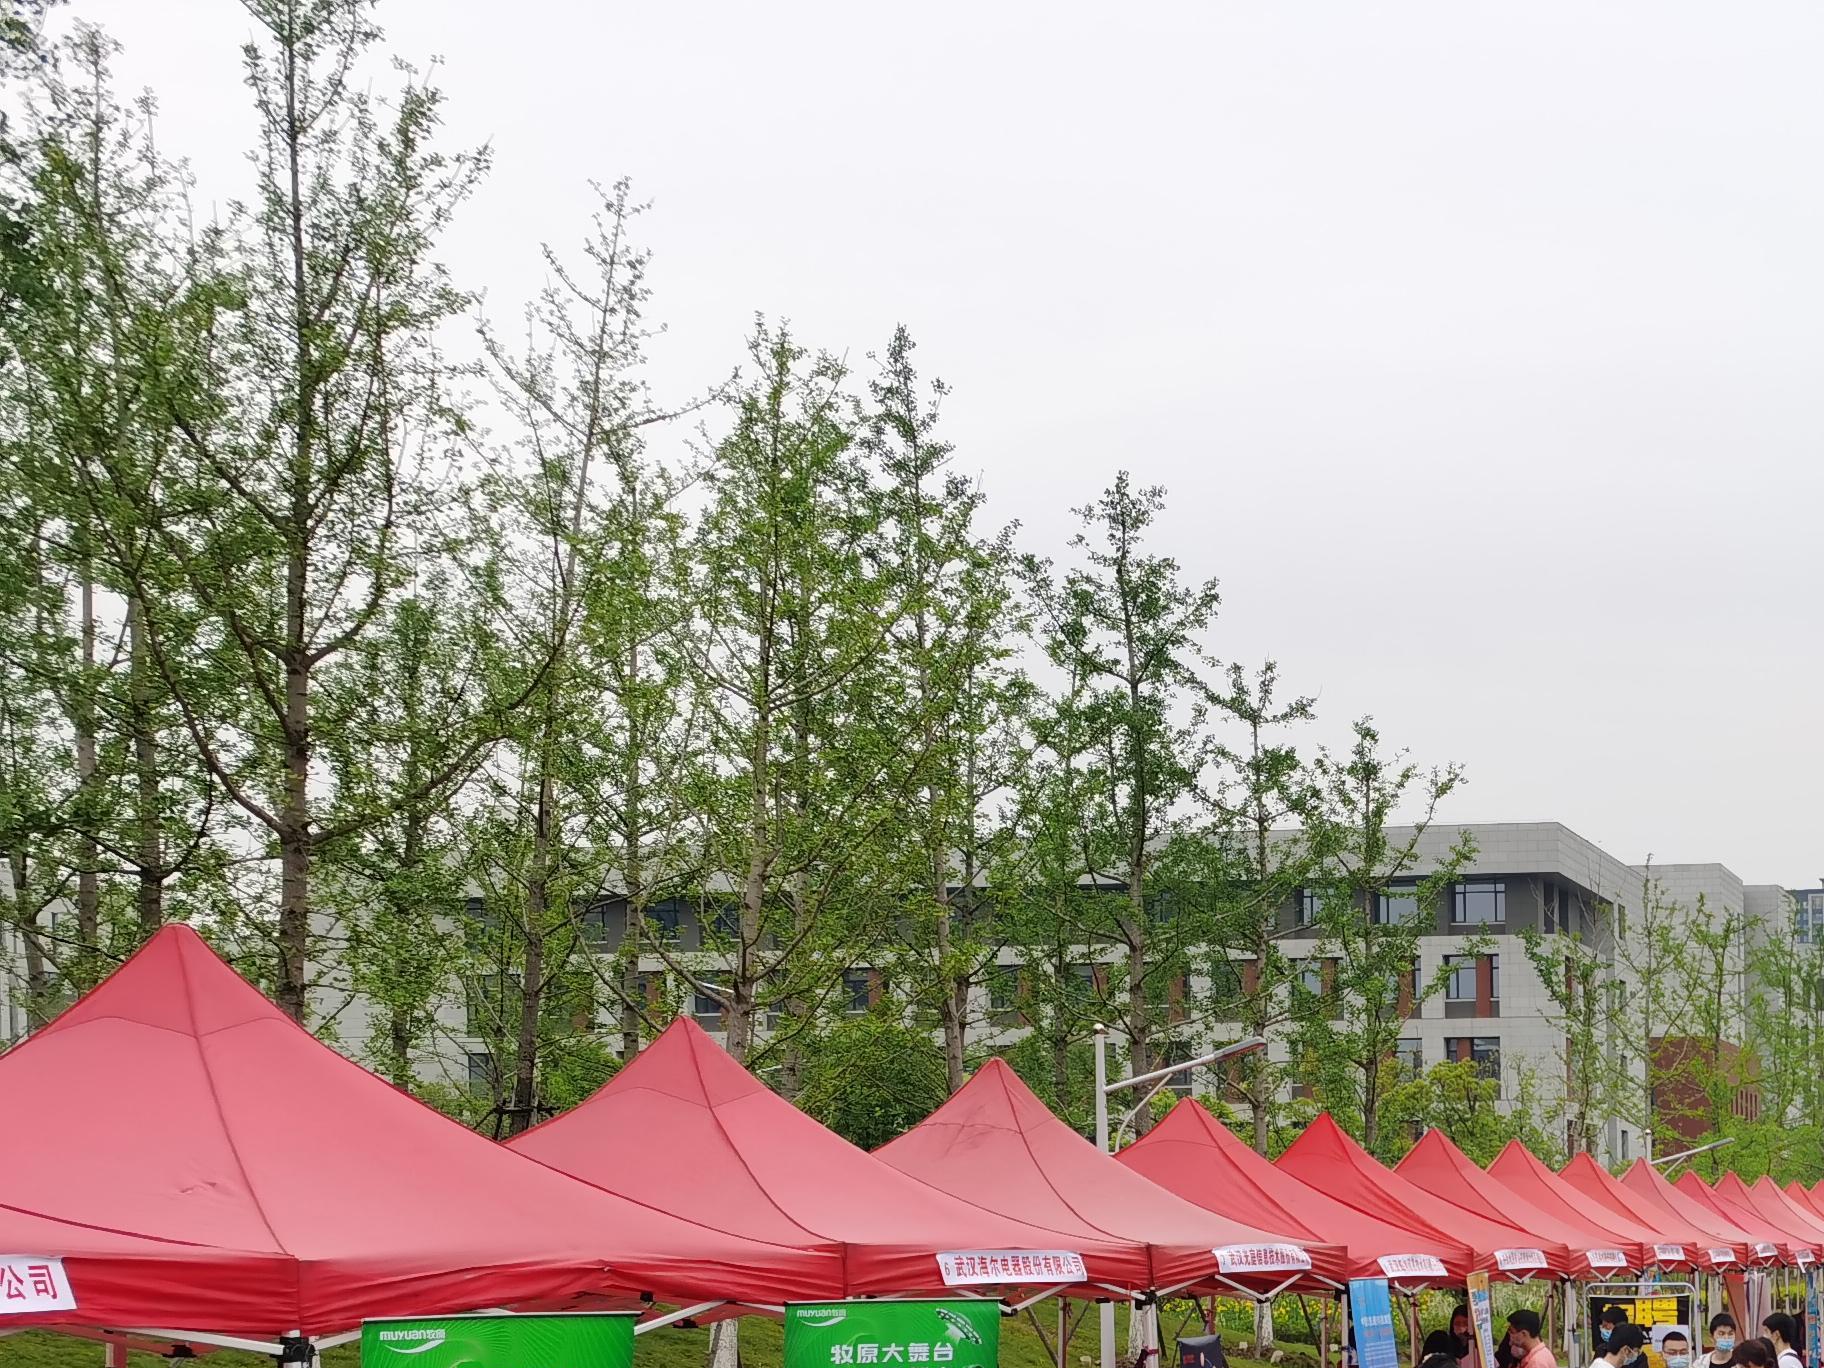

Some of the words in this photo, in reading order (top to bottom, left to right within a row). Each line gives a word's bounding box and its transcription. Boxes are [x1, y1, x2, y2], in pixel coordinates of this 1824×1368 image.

[954, 1255, 1084, 1277] 武汉海尔电器股份有限公司
[830, 1343, 954, 1365] 牧原大舞台
